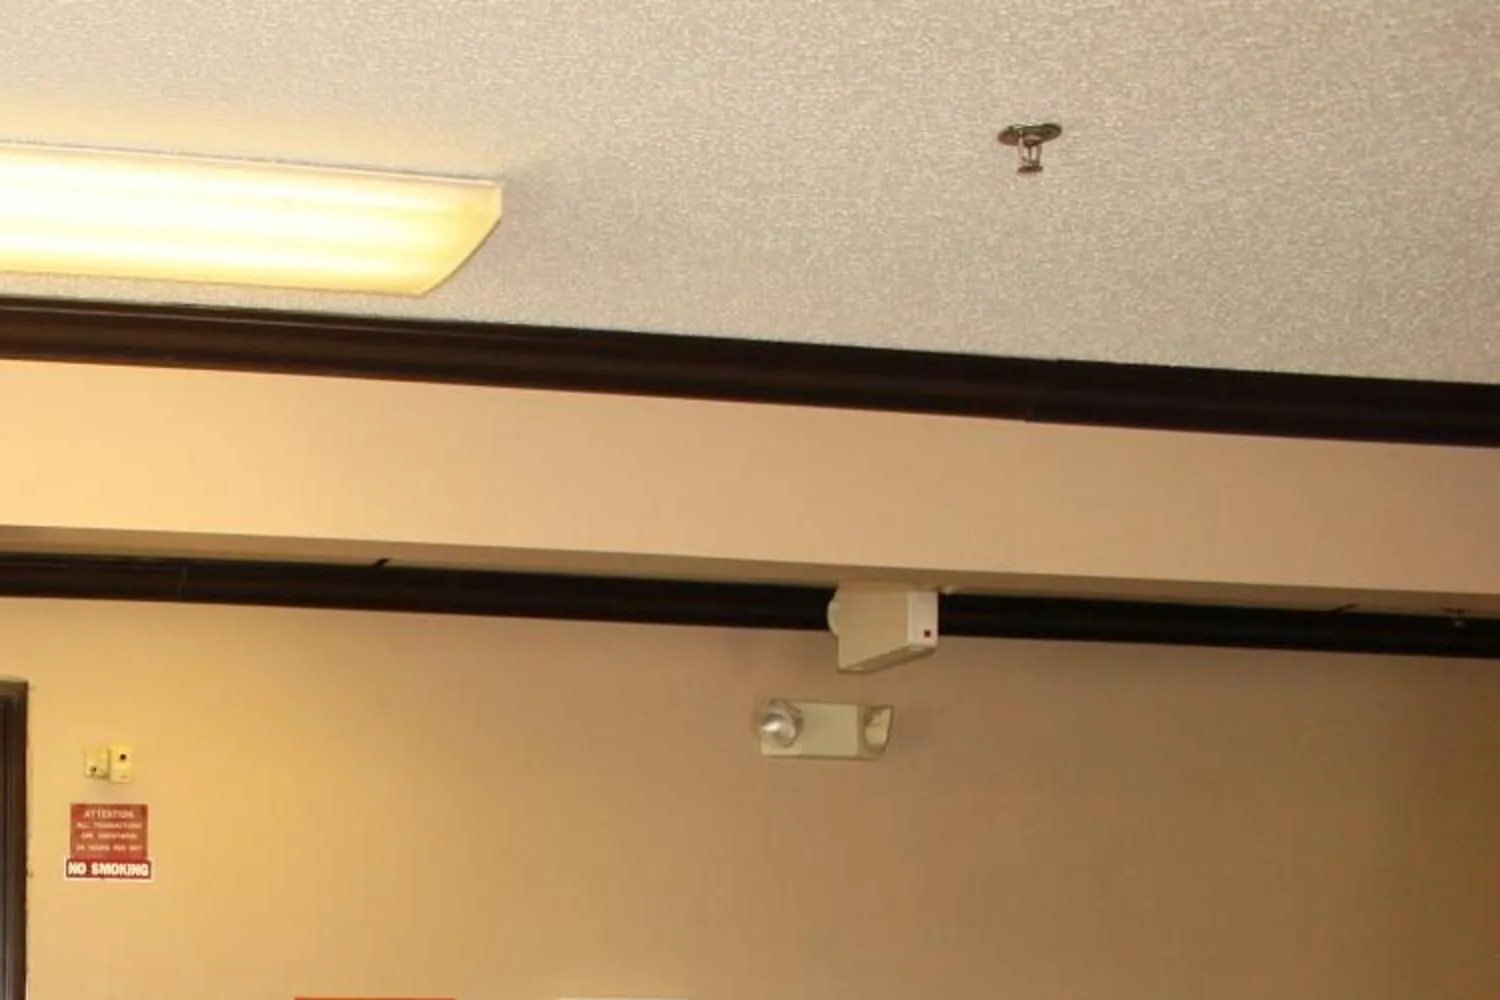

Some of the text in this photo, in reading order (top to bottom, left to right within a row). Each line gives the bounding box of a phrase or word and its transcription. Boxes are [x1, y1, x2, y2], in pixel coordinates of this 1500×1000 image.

[83, 809, 135, 819] ATTENTION
[67, 861, 150, 877] NO SMOKING
